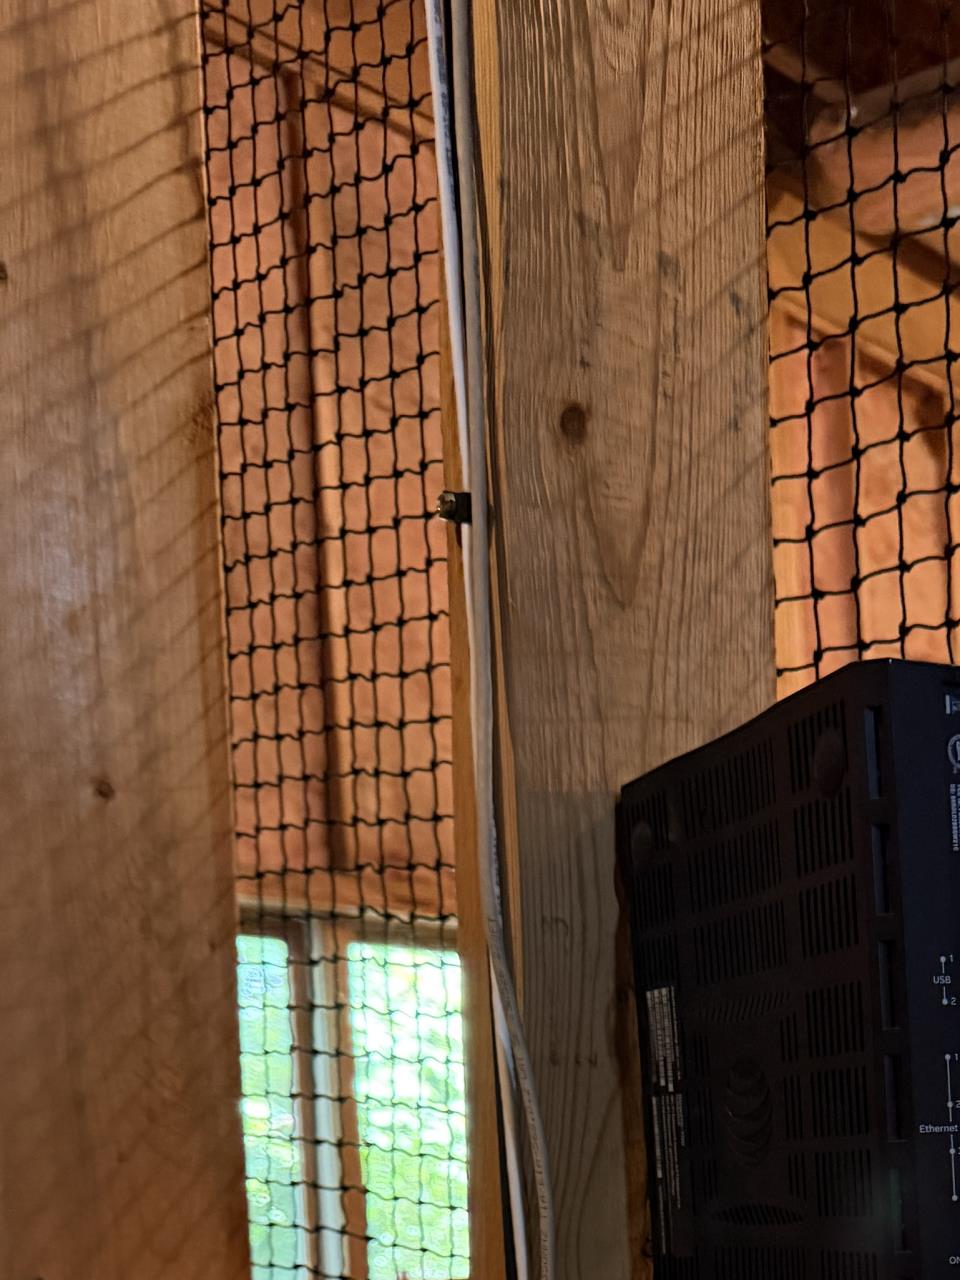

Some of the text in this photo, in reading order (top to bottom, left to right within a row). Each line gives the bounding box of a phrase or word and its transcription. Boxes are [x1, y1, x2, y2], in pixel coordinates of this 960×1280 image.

[933, 975, 951, 984] USB
[950, 997, 957, 1006] 2
[919, 1124, 958, 1133] Ethernet
